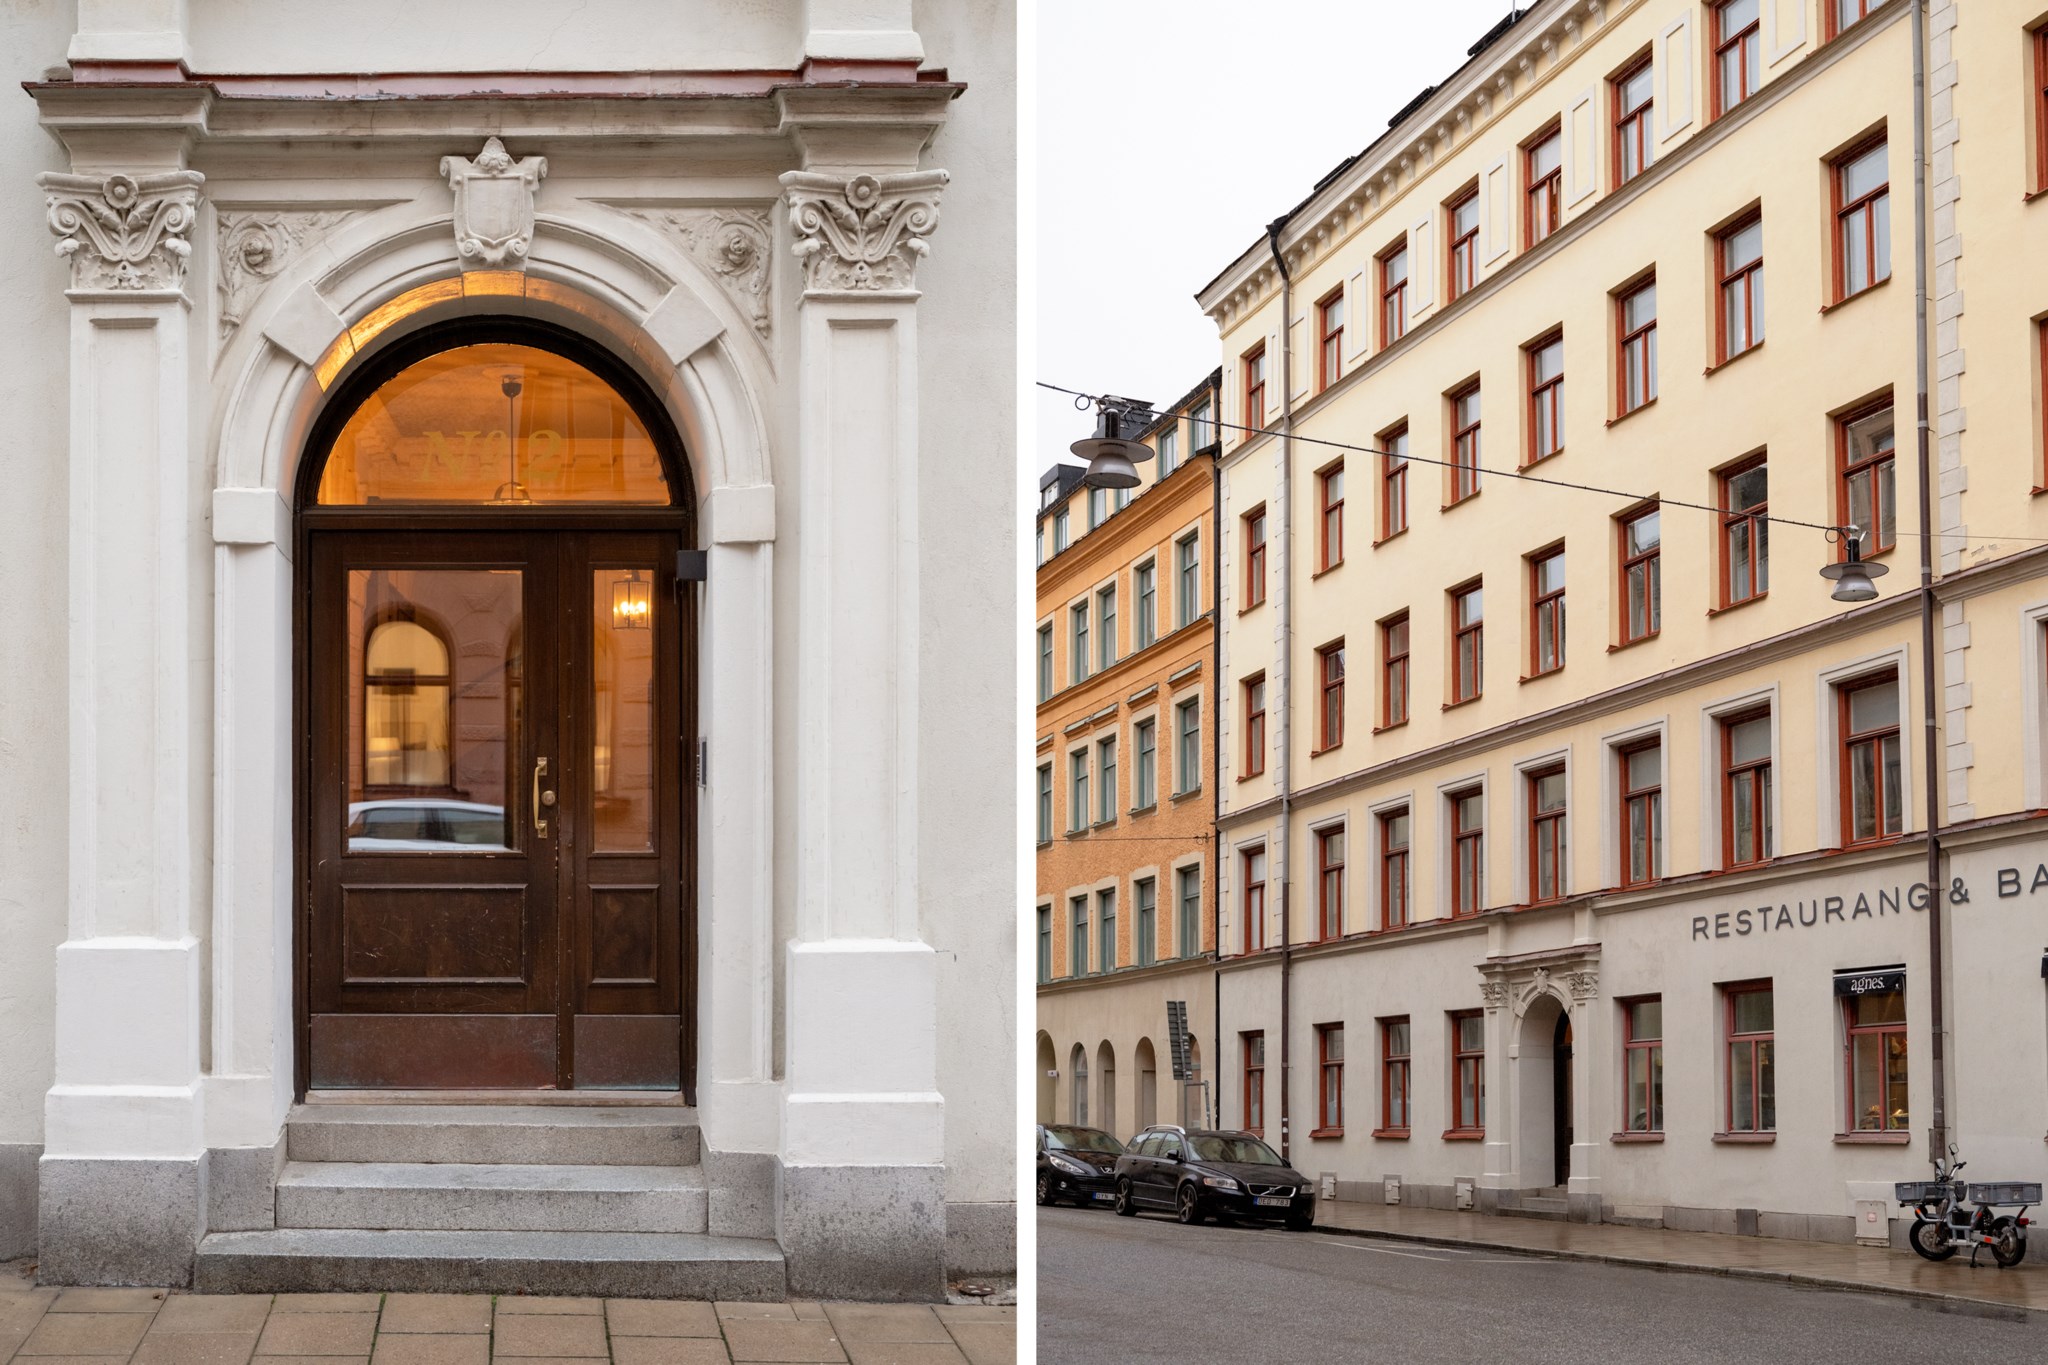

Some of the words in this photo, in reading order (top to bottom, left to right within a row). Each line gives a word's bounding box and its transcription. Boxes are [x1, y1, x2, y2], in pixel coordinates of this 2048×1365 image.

[521, 429, 562, 482] 2
[1692, 882, 1930, 941] RESTAURANG
[1949, 876, 1970, 905] &
